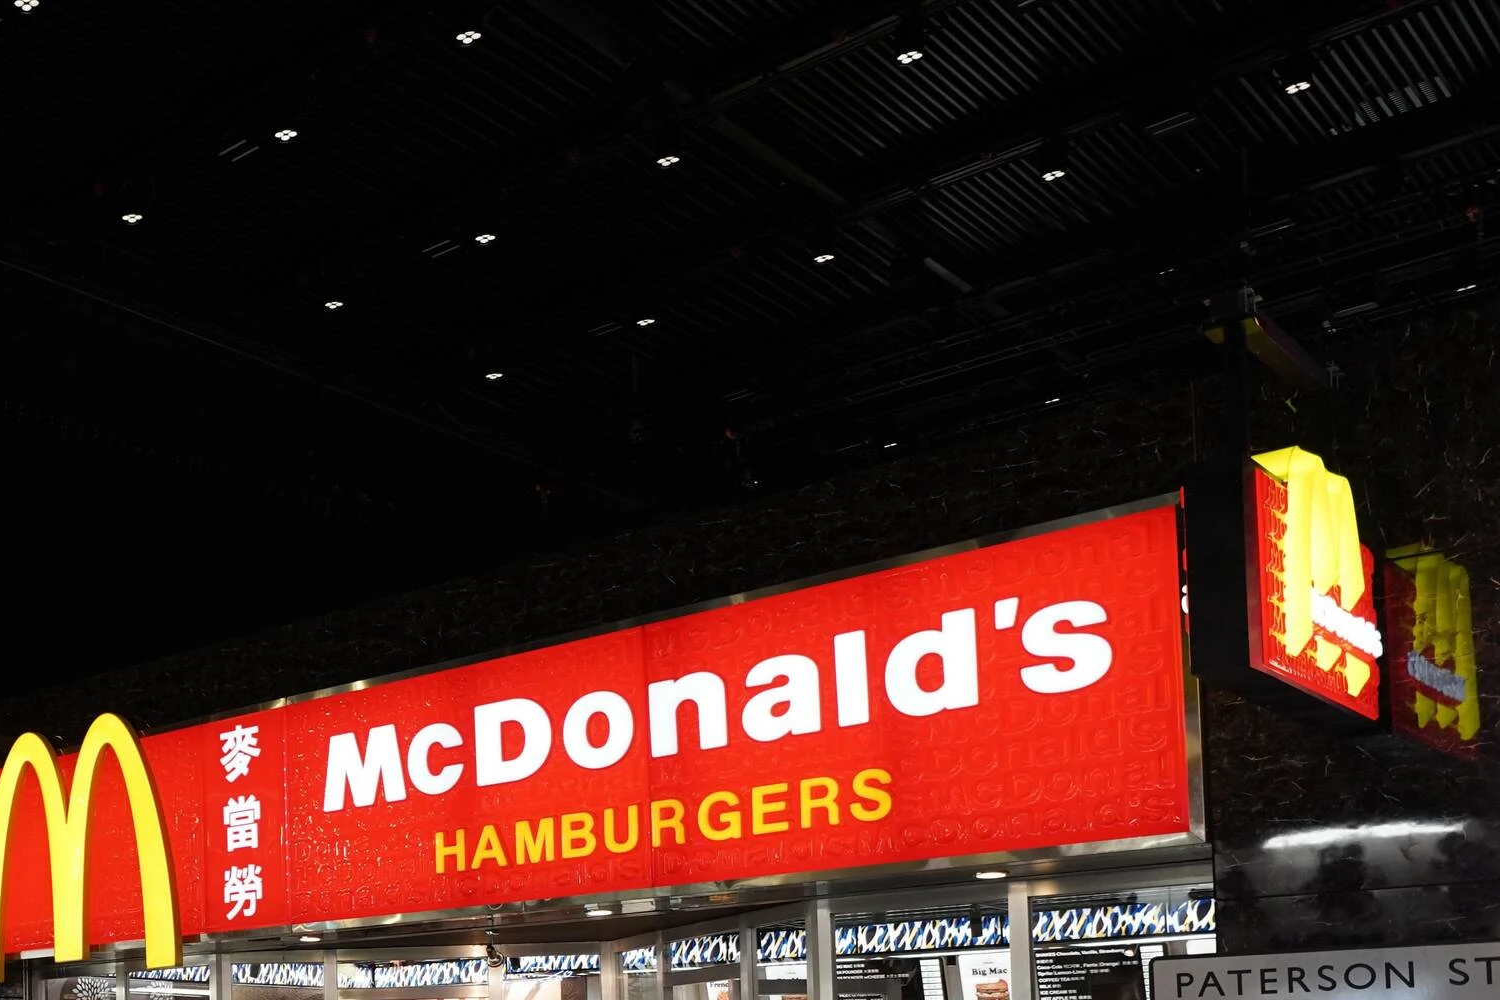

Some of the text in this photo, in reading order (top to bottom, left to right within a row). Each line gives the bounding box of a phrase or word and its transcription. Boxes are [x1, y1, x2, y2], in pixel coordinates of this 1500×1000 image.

[322, 596, 1114, 814] McDonald's
[219, 724, 263, 921] 麥當勞
[435, 767, 893, 875] HAMBURGERS
[971, 967, 1008, 976] Big Mac
[1176, 960, 1416, 999] PATERSON
